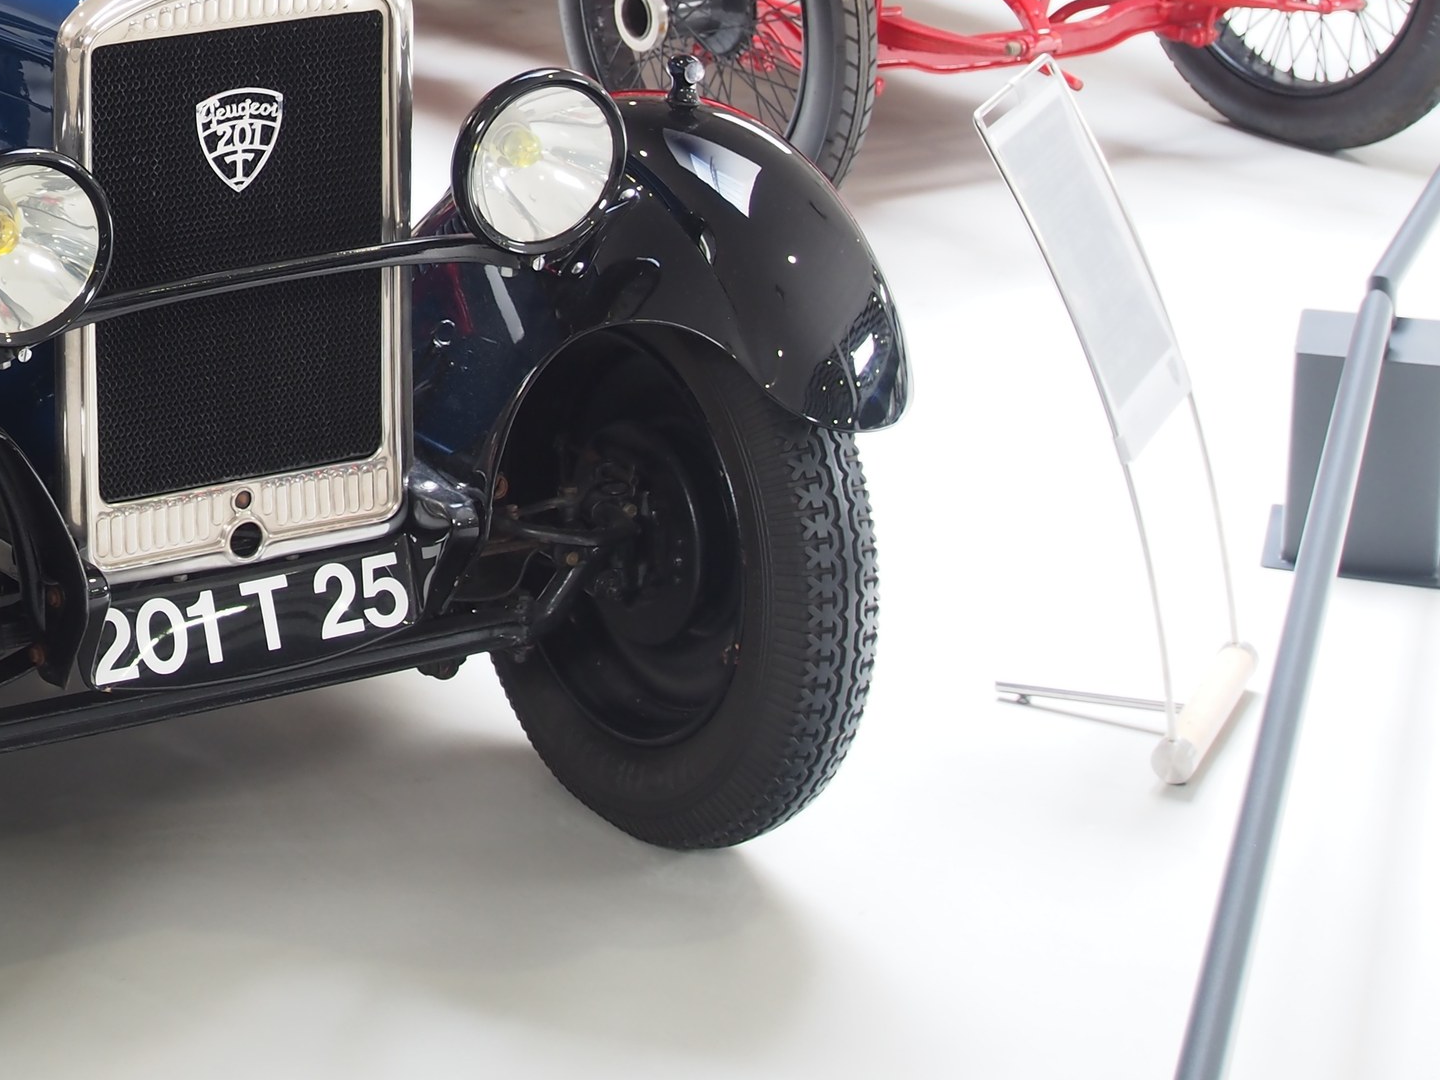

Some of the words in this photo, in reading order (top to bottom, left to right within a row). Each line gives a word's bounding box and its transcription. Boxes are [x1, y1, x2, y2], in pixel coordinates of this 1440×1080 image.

[201, 99, 278, 129] Peugeot
[216, 122, 262, 151] 201
[224, 151, 255, 179] T
[95, 590, 223, 686] 201
[239, 575, 288, 651] T
[313, 552, 409, 640] 25
